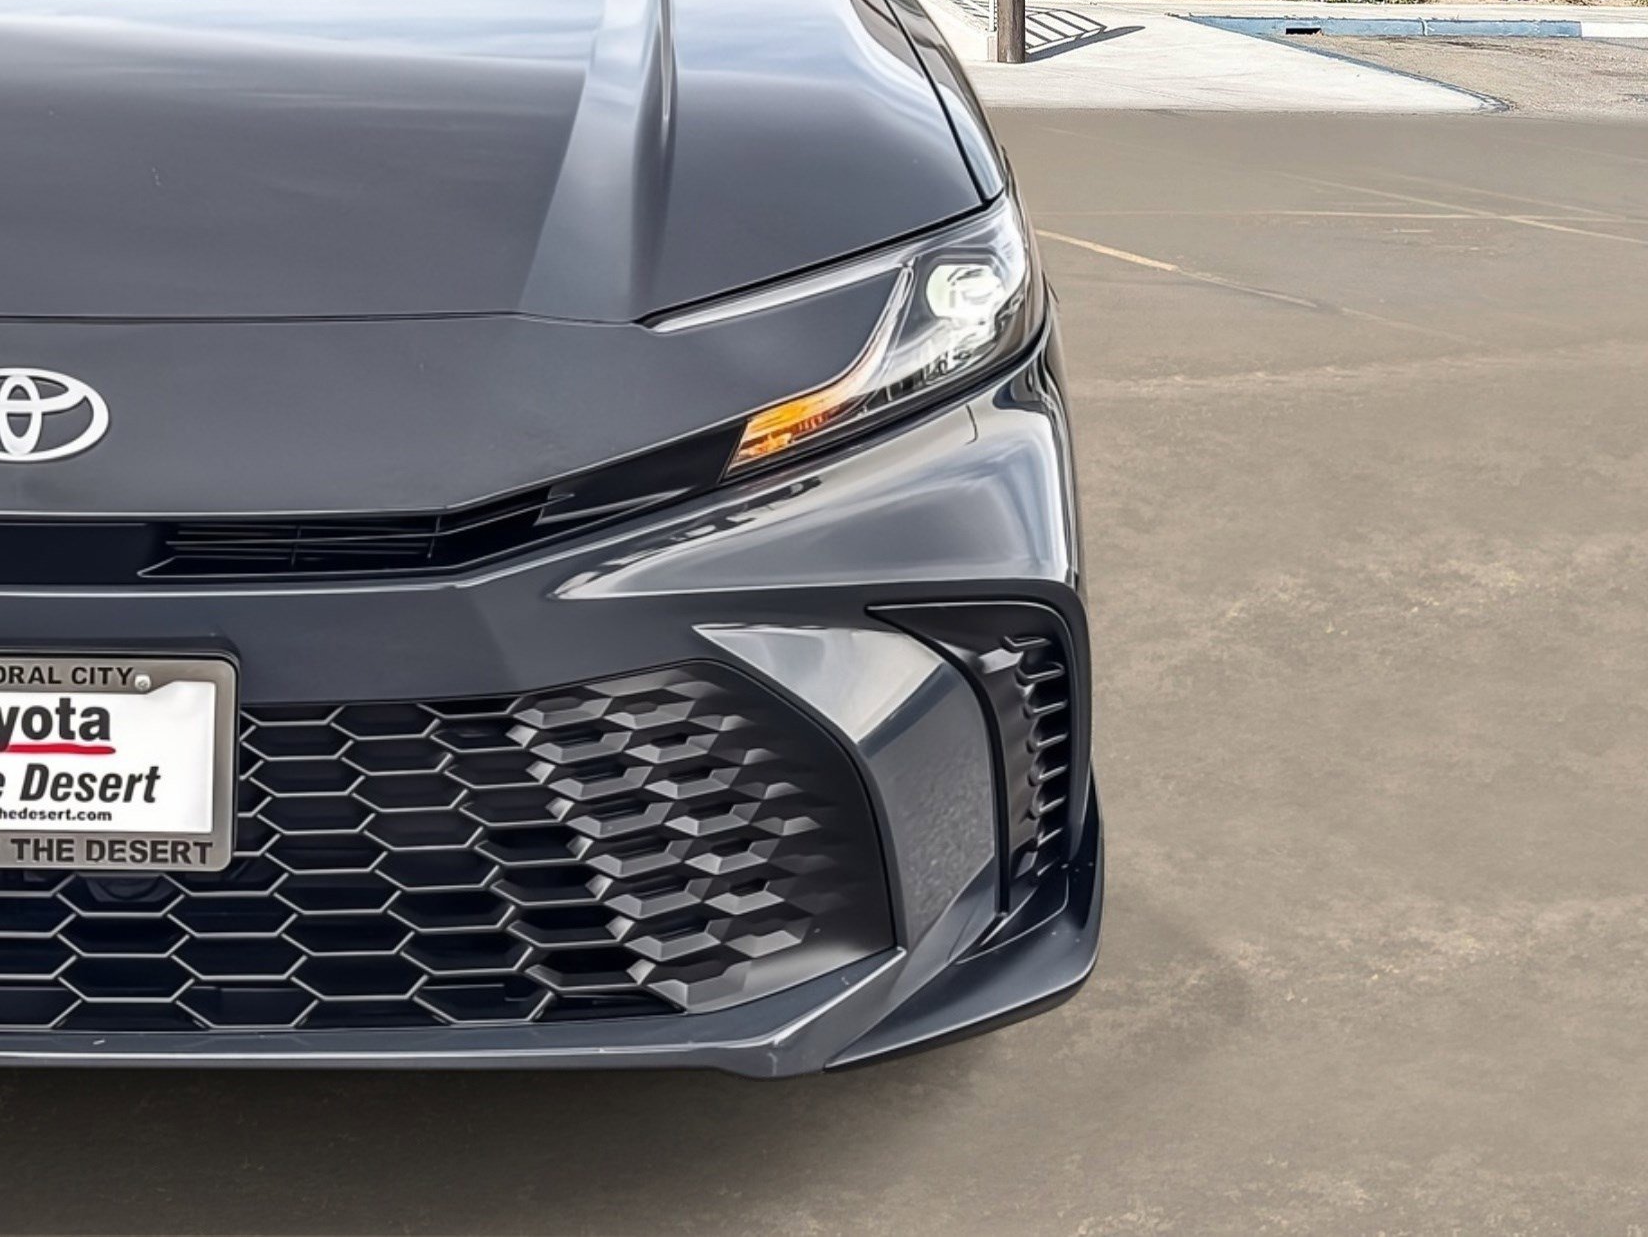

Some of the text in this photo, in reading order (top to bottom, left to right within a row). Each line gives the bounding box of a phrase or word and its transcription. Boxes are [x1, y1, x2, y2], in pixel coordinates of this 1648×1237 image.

[71, 666, 134, 686] CITY
[19, 763, 161, 803] Desert
[11, 837, 75, 862] THE
[85, 838, 213, 864] DESERT
